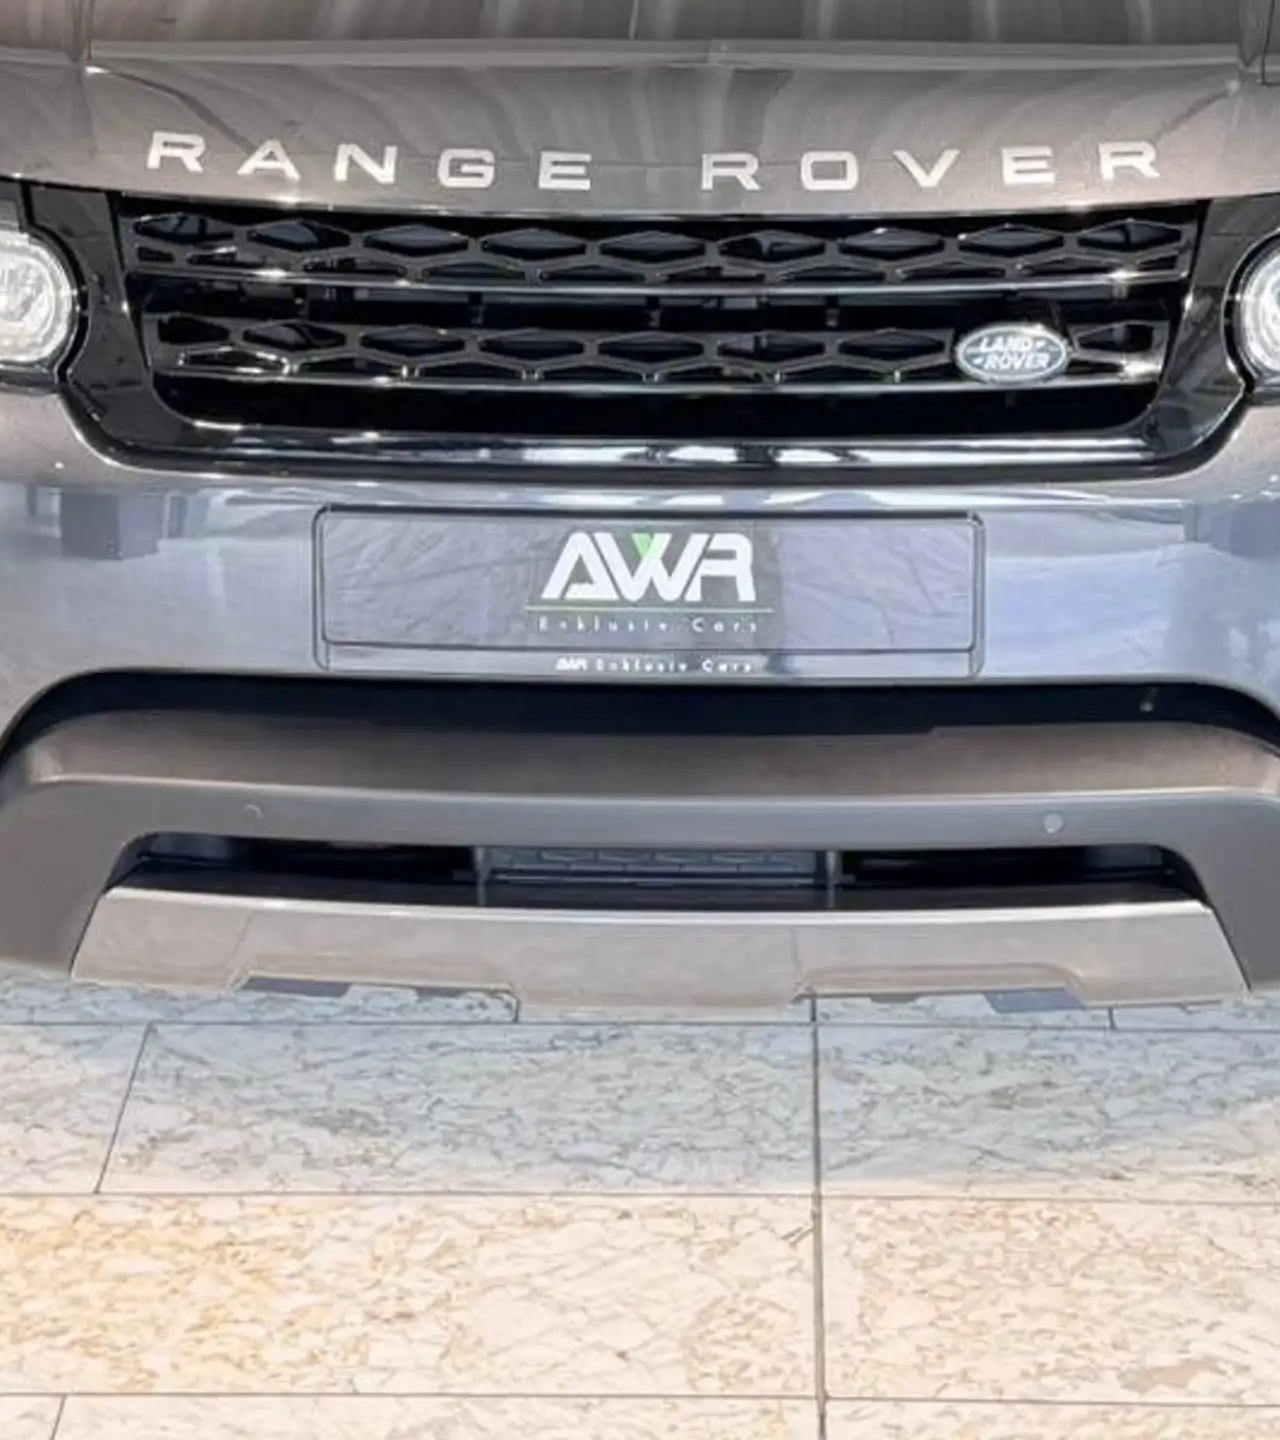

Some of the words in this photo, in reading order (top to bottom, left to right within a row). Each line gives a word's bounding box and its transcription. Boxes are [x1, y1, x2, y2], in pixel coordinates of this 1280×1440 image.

[147, 131, 591, 191] RANGE
[701, 141, 1160, 191] ROVER
[980, 336, 1033, 352] LAND
[983, 353, 1050, 369] ROVER
[541, 531, 757, 602] AWR
[691, 616, 757, 633] Cars
